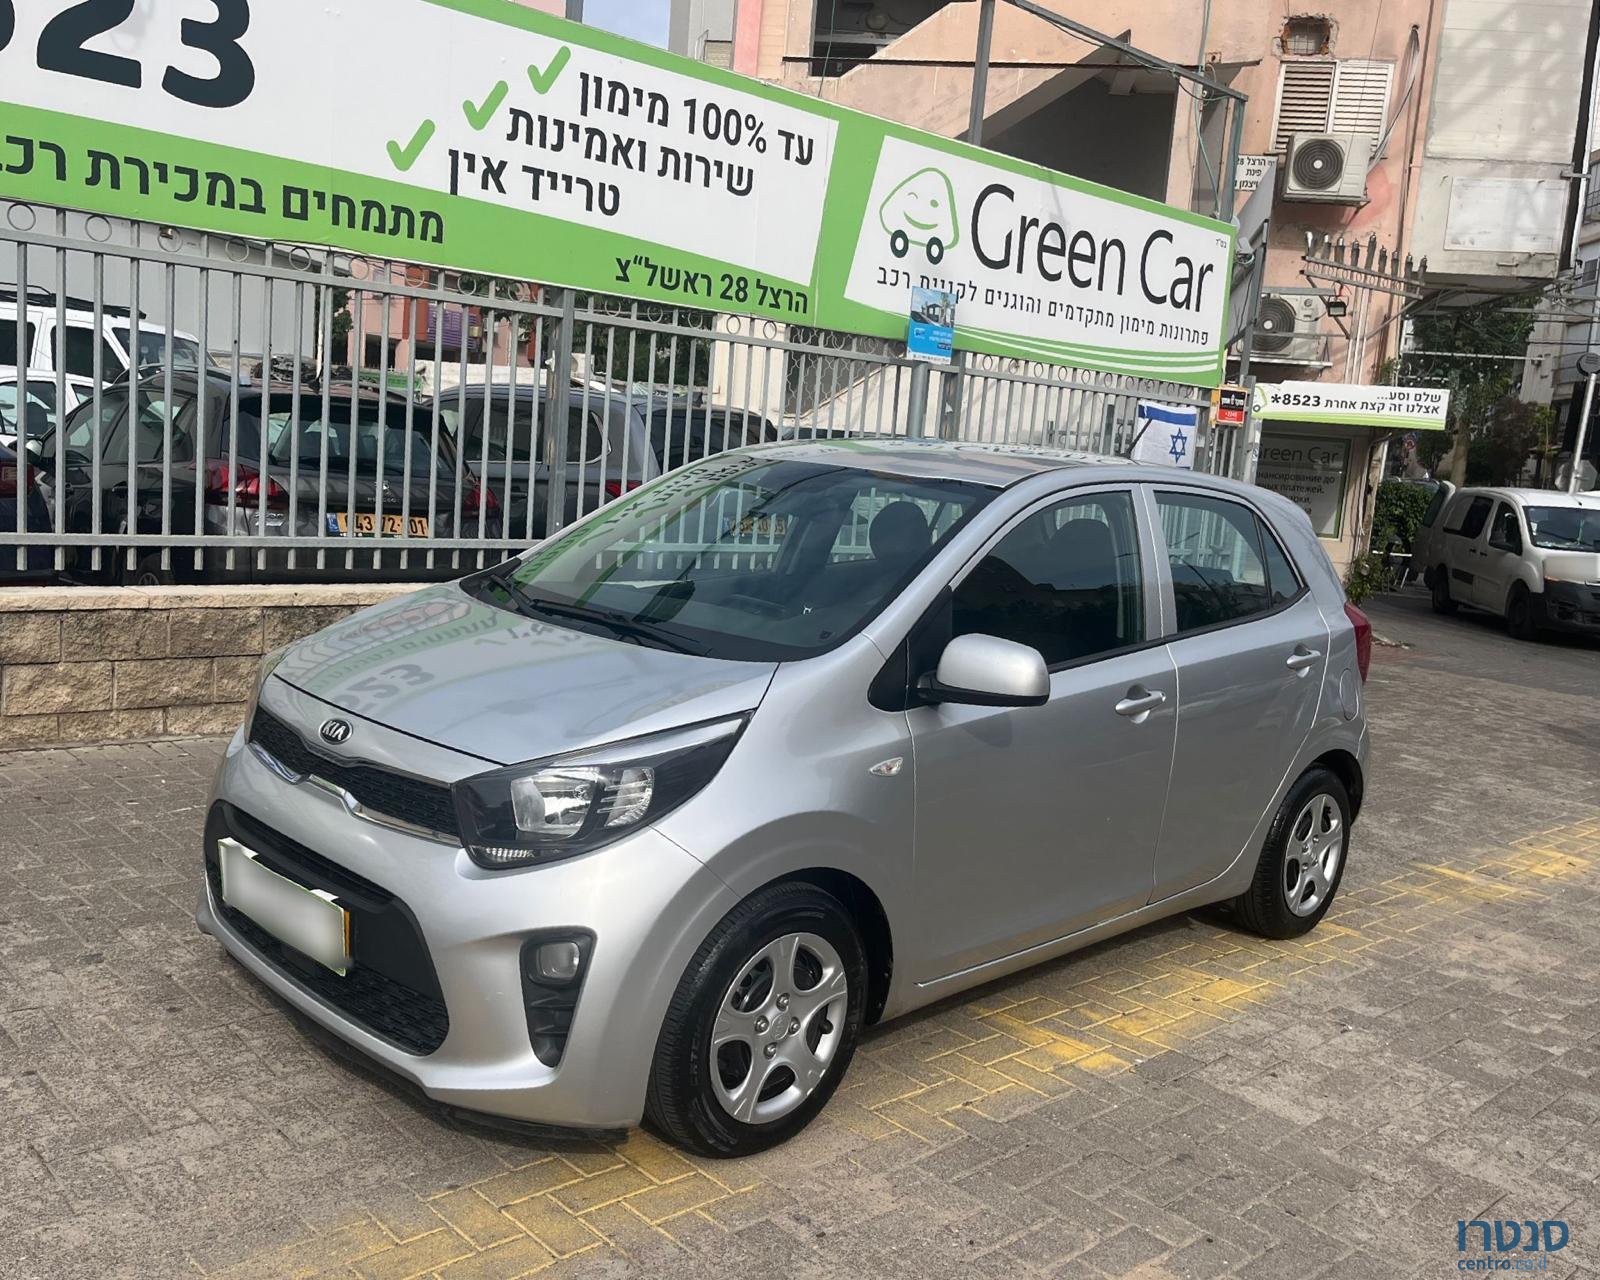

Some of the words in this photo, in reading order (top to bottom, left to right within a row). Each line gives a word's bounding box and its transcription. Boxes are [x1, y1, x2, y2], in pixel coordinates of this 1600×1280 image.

[0, 0, 255, 108] 23
[579, 72, 669, 127] מימון
[507, 107, 646, 172] ואמינות
[683, 98, 767, 154] 100%
[0, 135, 67, 182] רכ
[777, 129, 814, 166] עד
[85, 150, 266, 214] במכירת
[448, 148, 507, 196] אין
[657, 145, 754, 196] שירות
[522, 165, 620, 216] טרייד
[282, 185, 445, 244] מתמחים
[970, 183, 1125, 296] Green
[1140, 230, 1214, 313] Car
[720, 273, 749, 303] 28
[876, 266, 911, 289] רכב
[755, 279, 808, 315] הרצל
[985, 288, 1042, 314] והוגנים
[1048, 301, 1114, 328] מתקדמים
[1120, 314, 1155, 335] מימון
[1159, 322, 1209, 346] פתרונות
[1324, 399, 1356, 409] אחרת
[1360, 401, 1386, 413] קצת
[1388, 402, 1403, 412] זה
[1405, 403, 1440, 415] אצלנו
[1414, 392, 1442, 403] שלם
[1308, 446, 1339, 464] Car
[322, 720, 346, 741] KIA
